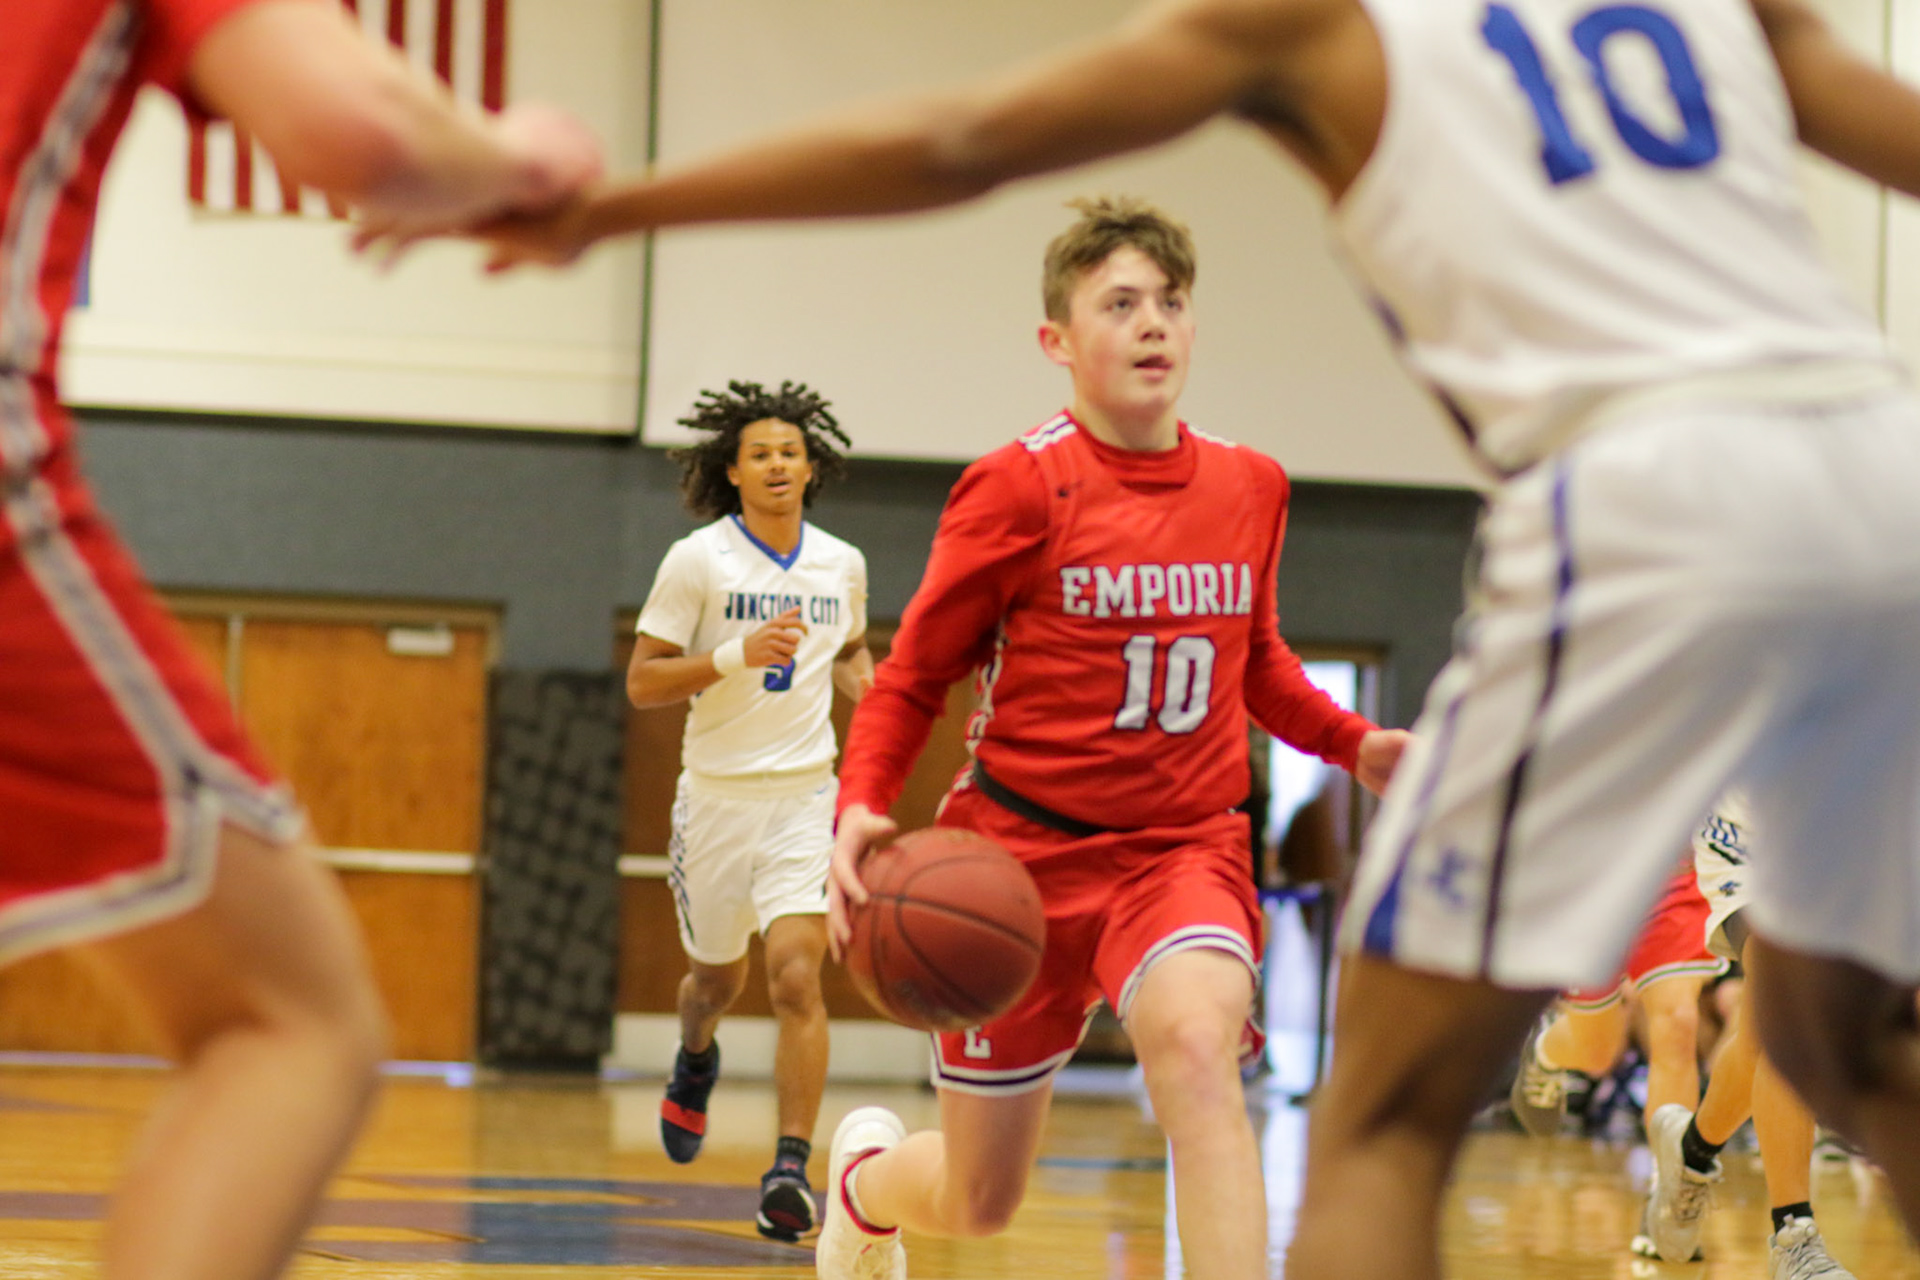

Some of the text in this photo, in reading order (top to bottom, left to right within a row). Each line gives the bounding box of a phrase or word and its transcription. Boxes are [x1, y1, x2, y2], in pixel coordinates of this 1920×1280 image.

[1481, 3, 1720, 185] 10
[725, 592, 839, 626] JUNCTION CITY
[1059, 562, 1253, 618] EMPORIA
[1113, 634, 1215, 734] 10
